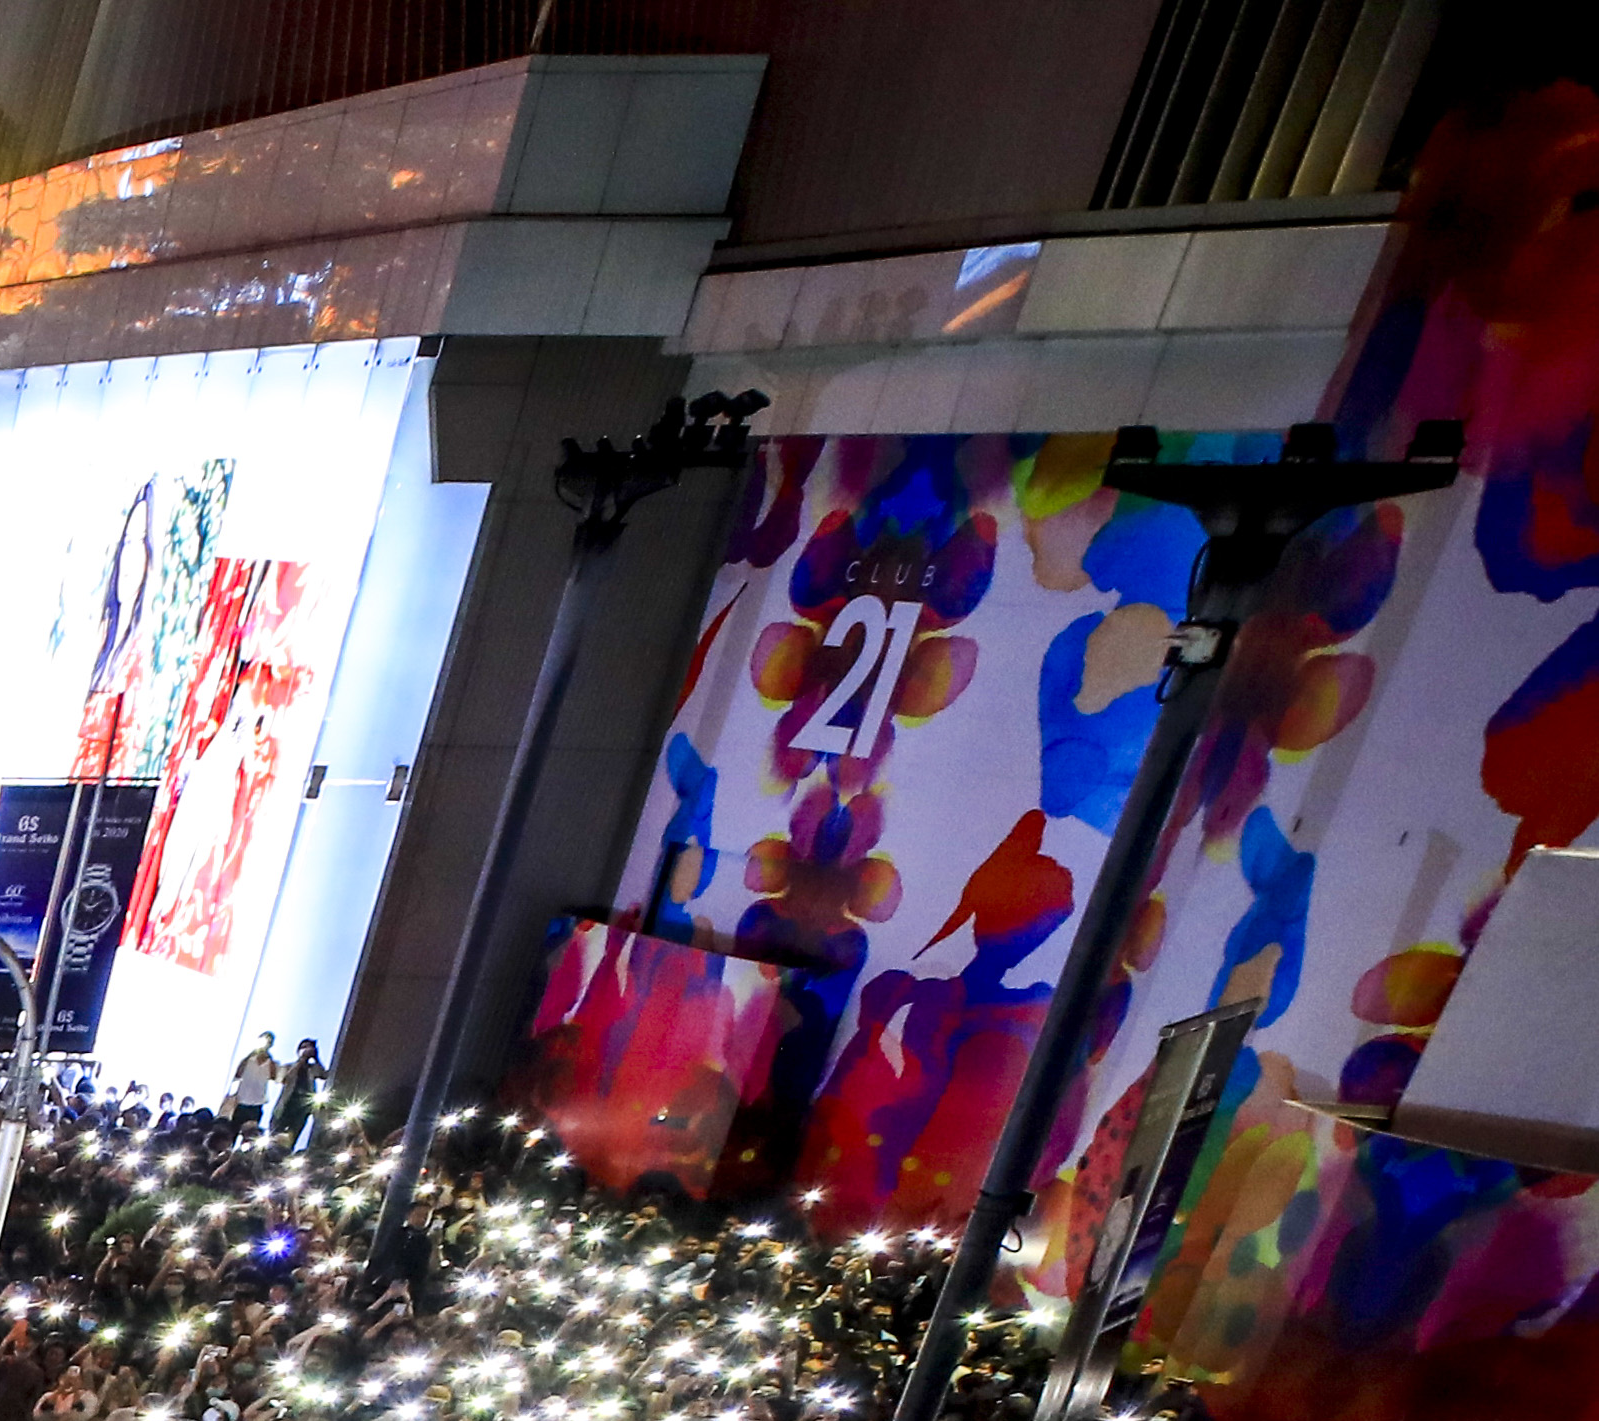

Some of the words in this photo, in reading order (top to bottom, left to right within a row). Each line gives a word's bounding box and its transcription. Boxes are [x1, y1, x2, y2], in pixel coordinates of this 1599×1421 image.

[845, 561, 936, 587] CLUB
[788, 595, 923, 759] 21
[18, 815, 40, 832] GS
[28, 833, 59, 844] Seiko
